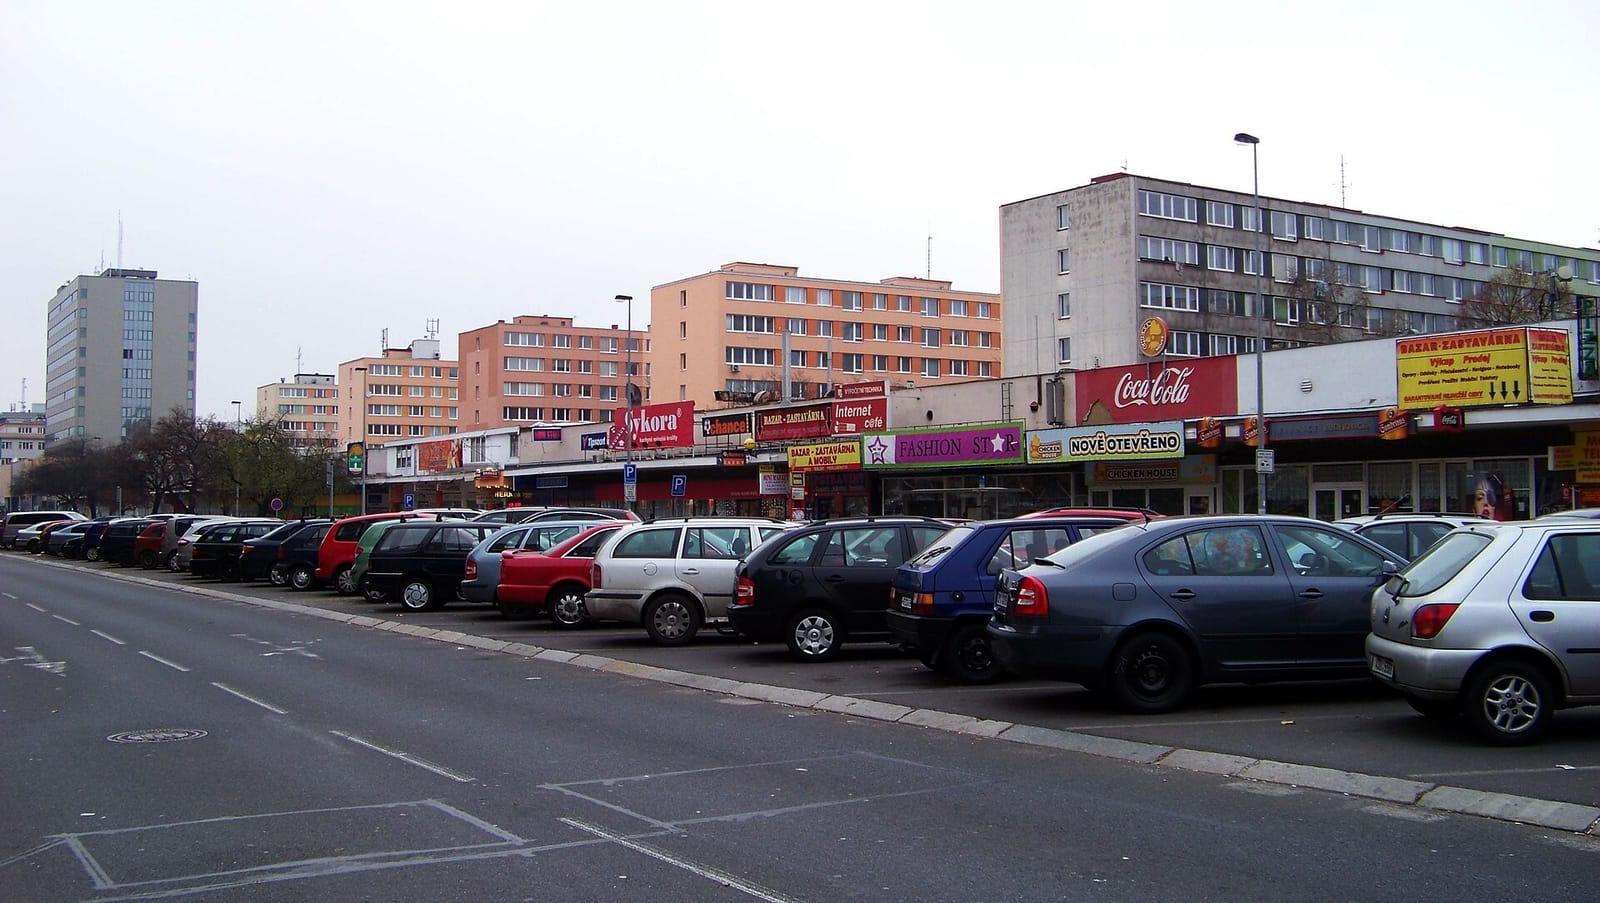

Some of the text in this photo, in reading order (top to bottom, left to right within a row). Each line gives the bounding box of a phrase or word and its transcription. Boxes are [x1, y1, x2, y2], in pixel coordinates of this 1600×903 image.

[1463, 353, 1491, 365] Prodej
[1114, 367, 1195, 408] Coca-Cola
[835, 404, 872, 418] Internet
[763, 413, 782, 425] BAZAR
[710, 419, 745, 435] chance
[900, 438, 961, 457] FASHION
[1072, 433, 1177, 451] NOVĚ OTEVŘENO
[791, 448, 810, 457] BAZAR
[815, 444, 856, 456] ZASTAVÁRNA
[808, 456, 837, 466] A MOBILY
[627, 466, 634, 477] P
[1108, 468, 1177, 479] CHICKEN HOUSE
[674, 478, 683, 490] P
